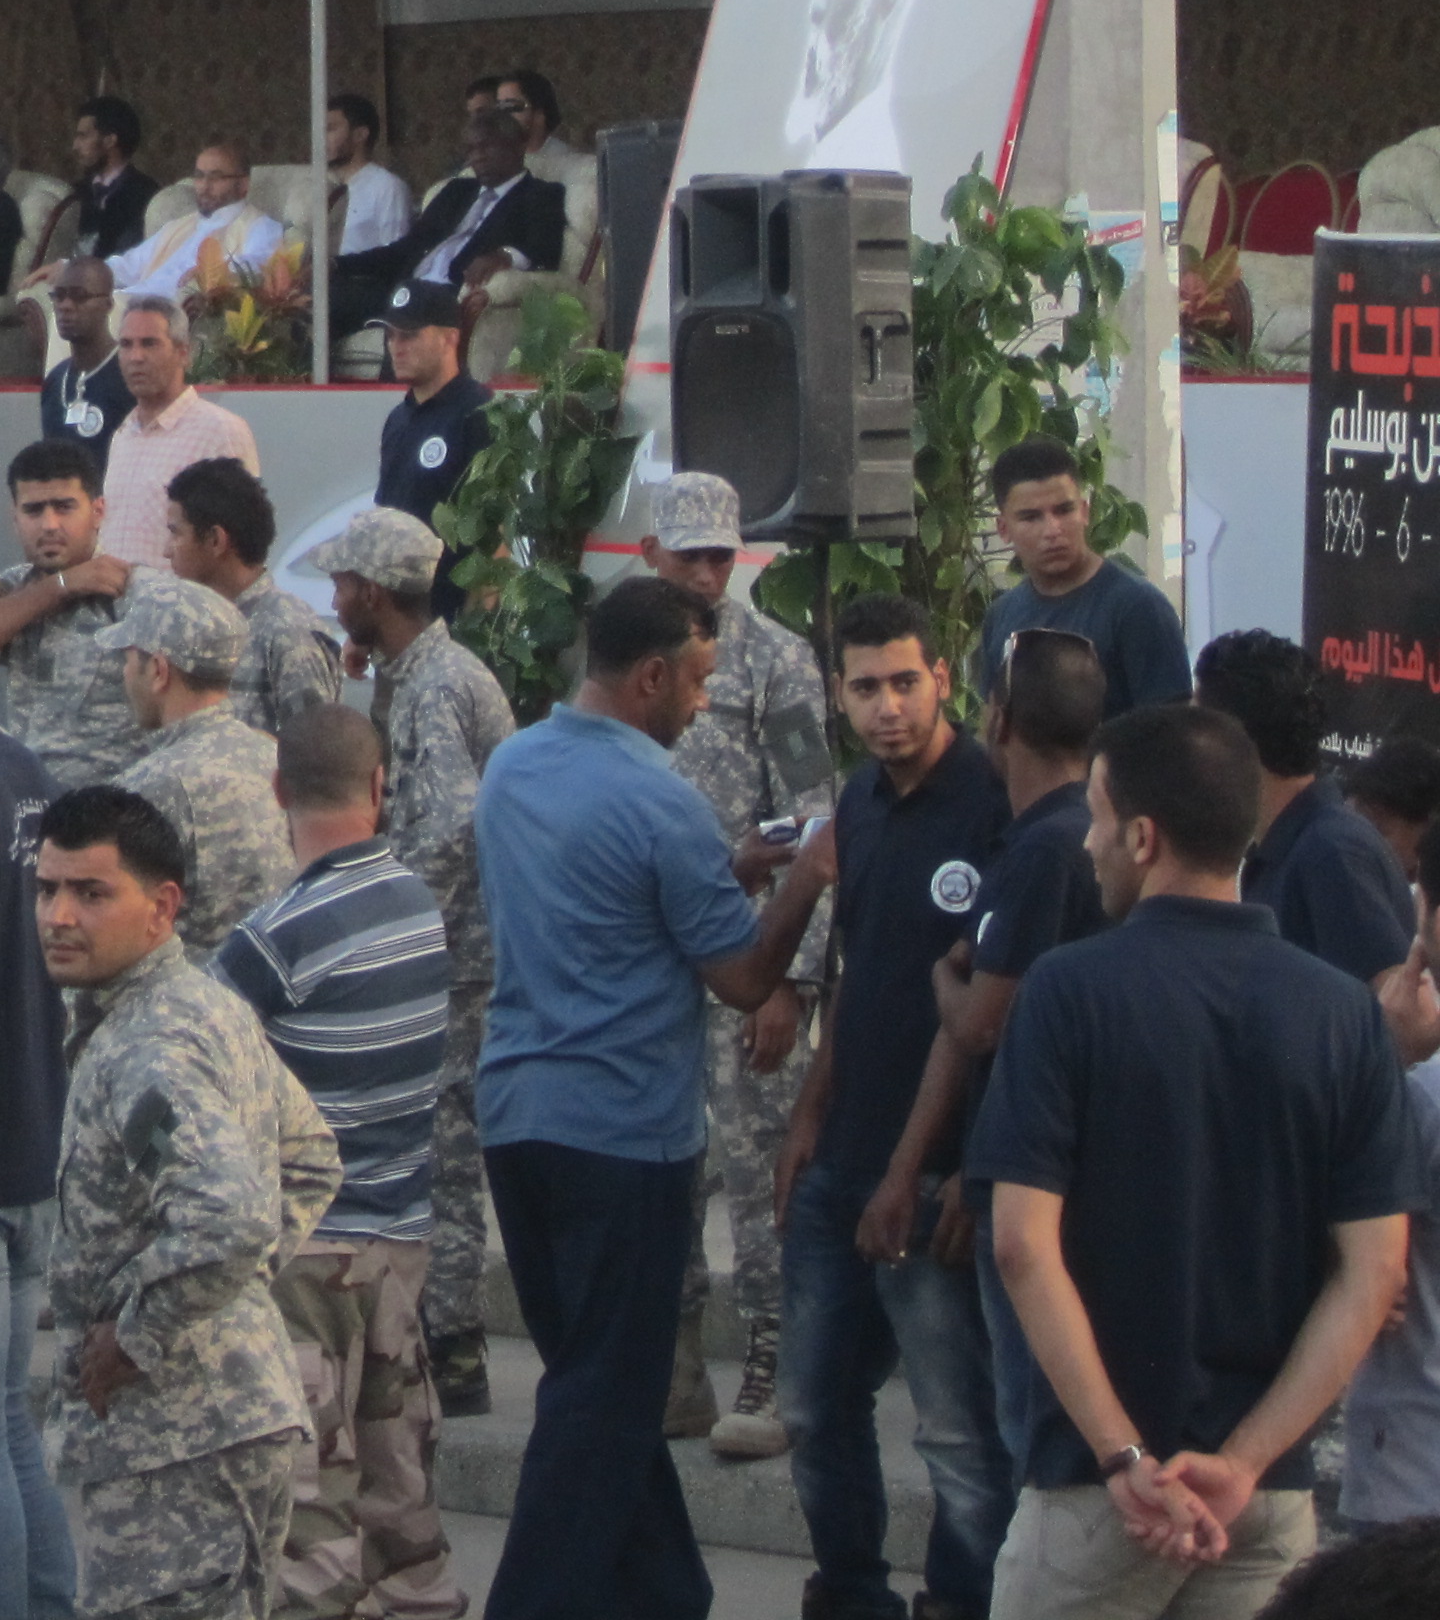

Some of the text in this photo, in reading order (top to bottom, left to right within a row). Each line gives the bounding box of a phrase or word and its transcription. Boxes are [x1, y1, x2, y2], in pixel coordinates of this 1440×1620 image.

[1325, 390, 1408, 482] بوسليم
[1323, 486, 1365, 557] 1996
[1395, 495, 1411, 563] 6
[1321, 630, 1380, 684] اليوم
[1383, 631, 1425, 682] هذا
